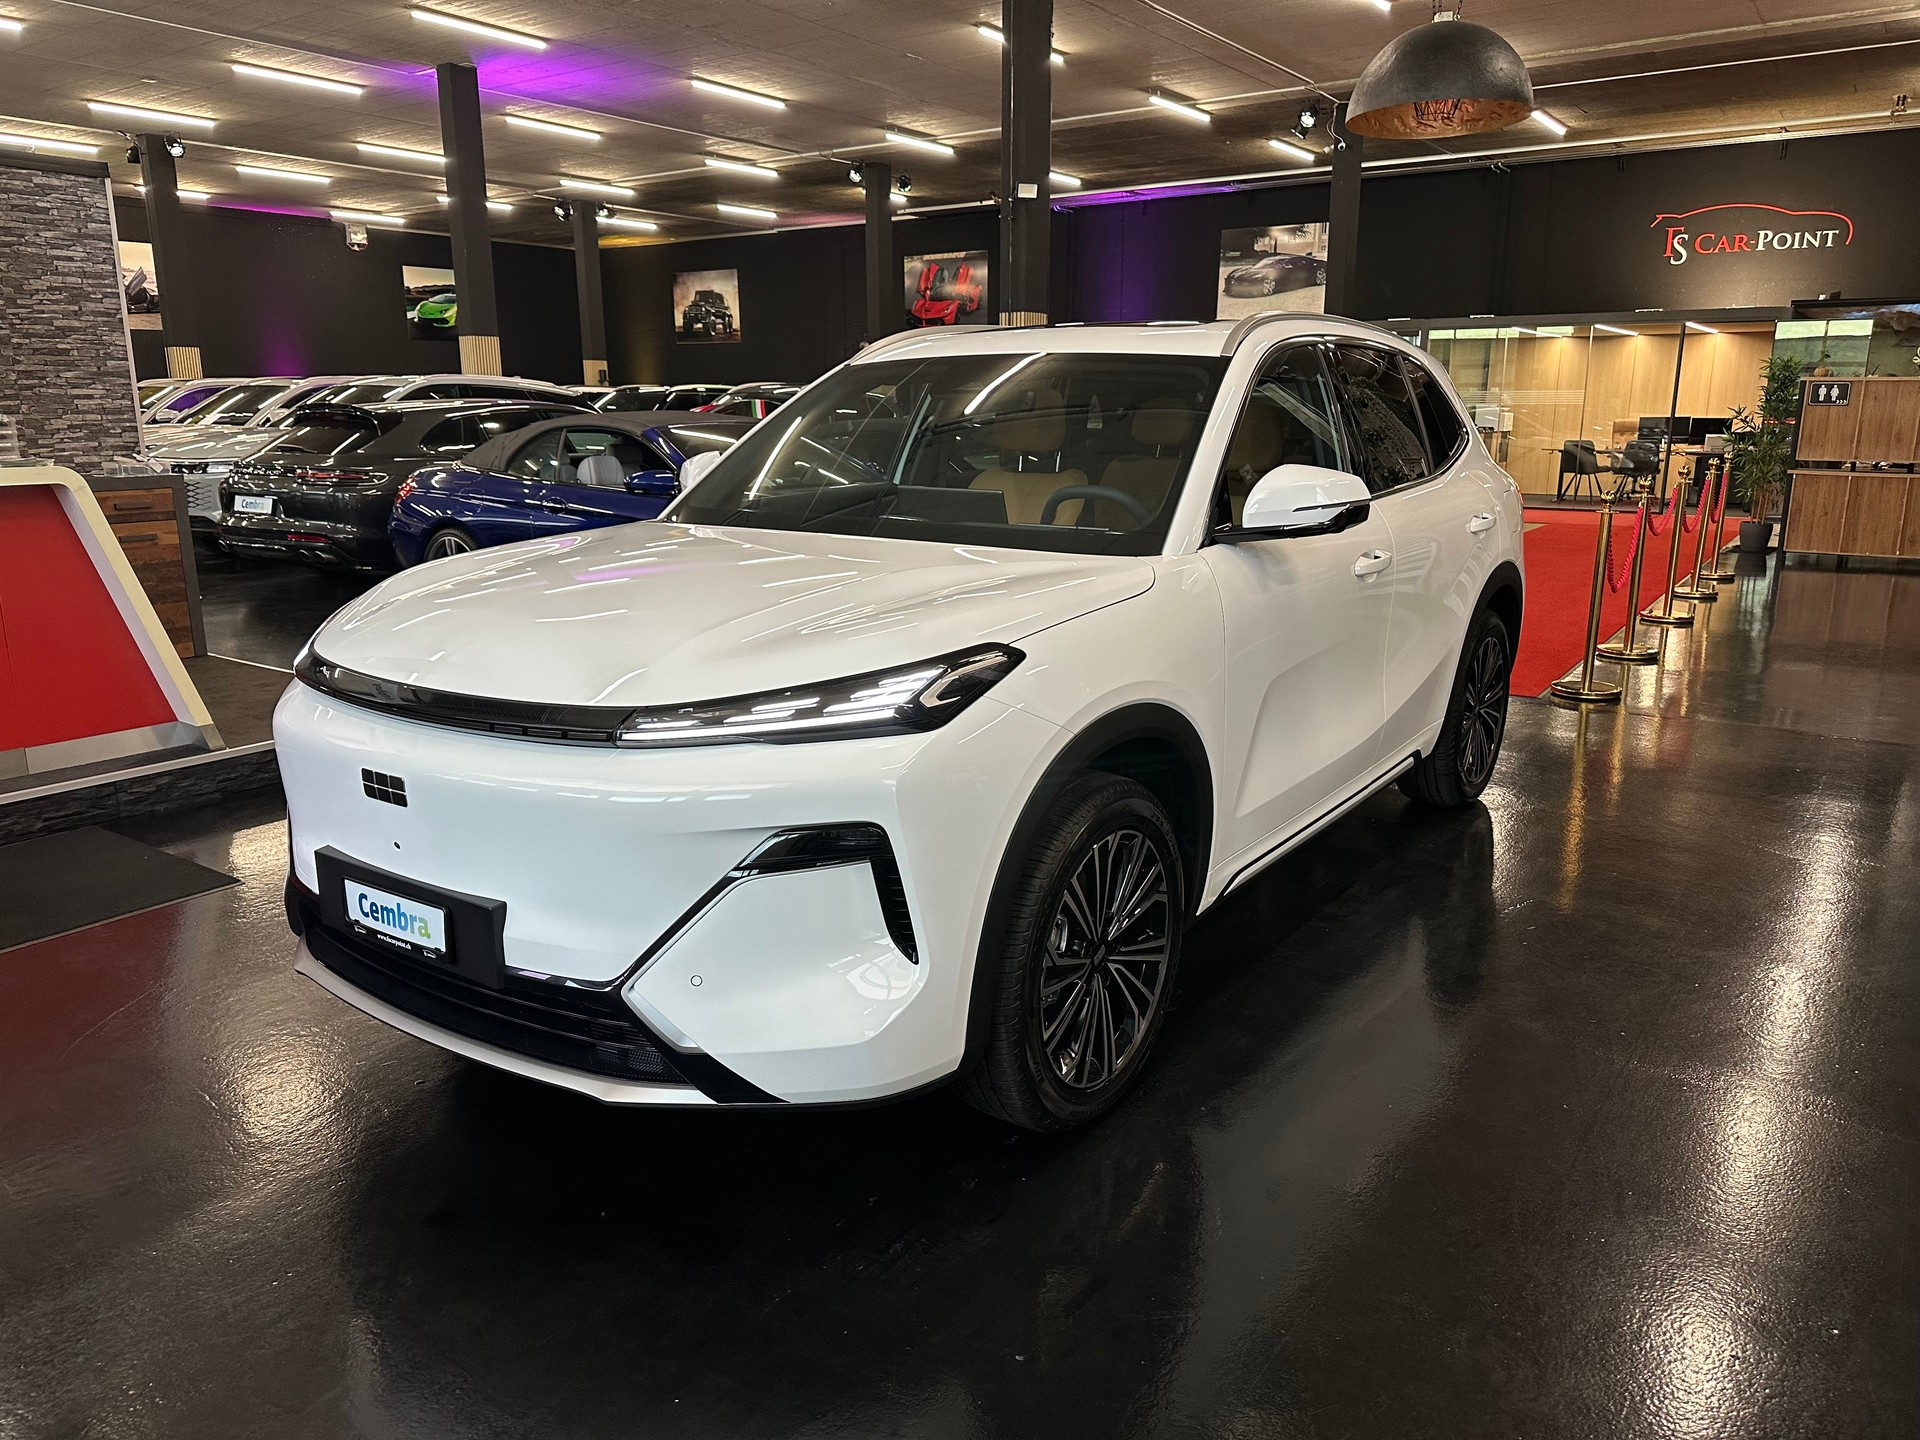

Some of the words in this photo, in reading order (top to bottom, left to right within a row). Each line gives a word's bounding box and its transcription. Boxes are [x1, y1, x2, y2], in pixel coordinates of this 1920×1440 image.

[1663, 226, 1688, 265] FS
[1694, 230, 1839, 254] CAR-POINT
[241, 499, 265, 511] Cembra
[358, 892, 431, 939] Cembra
